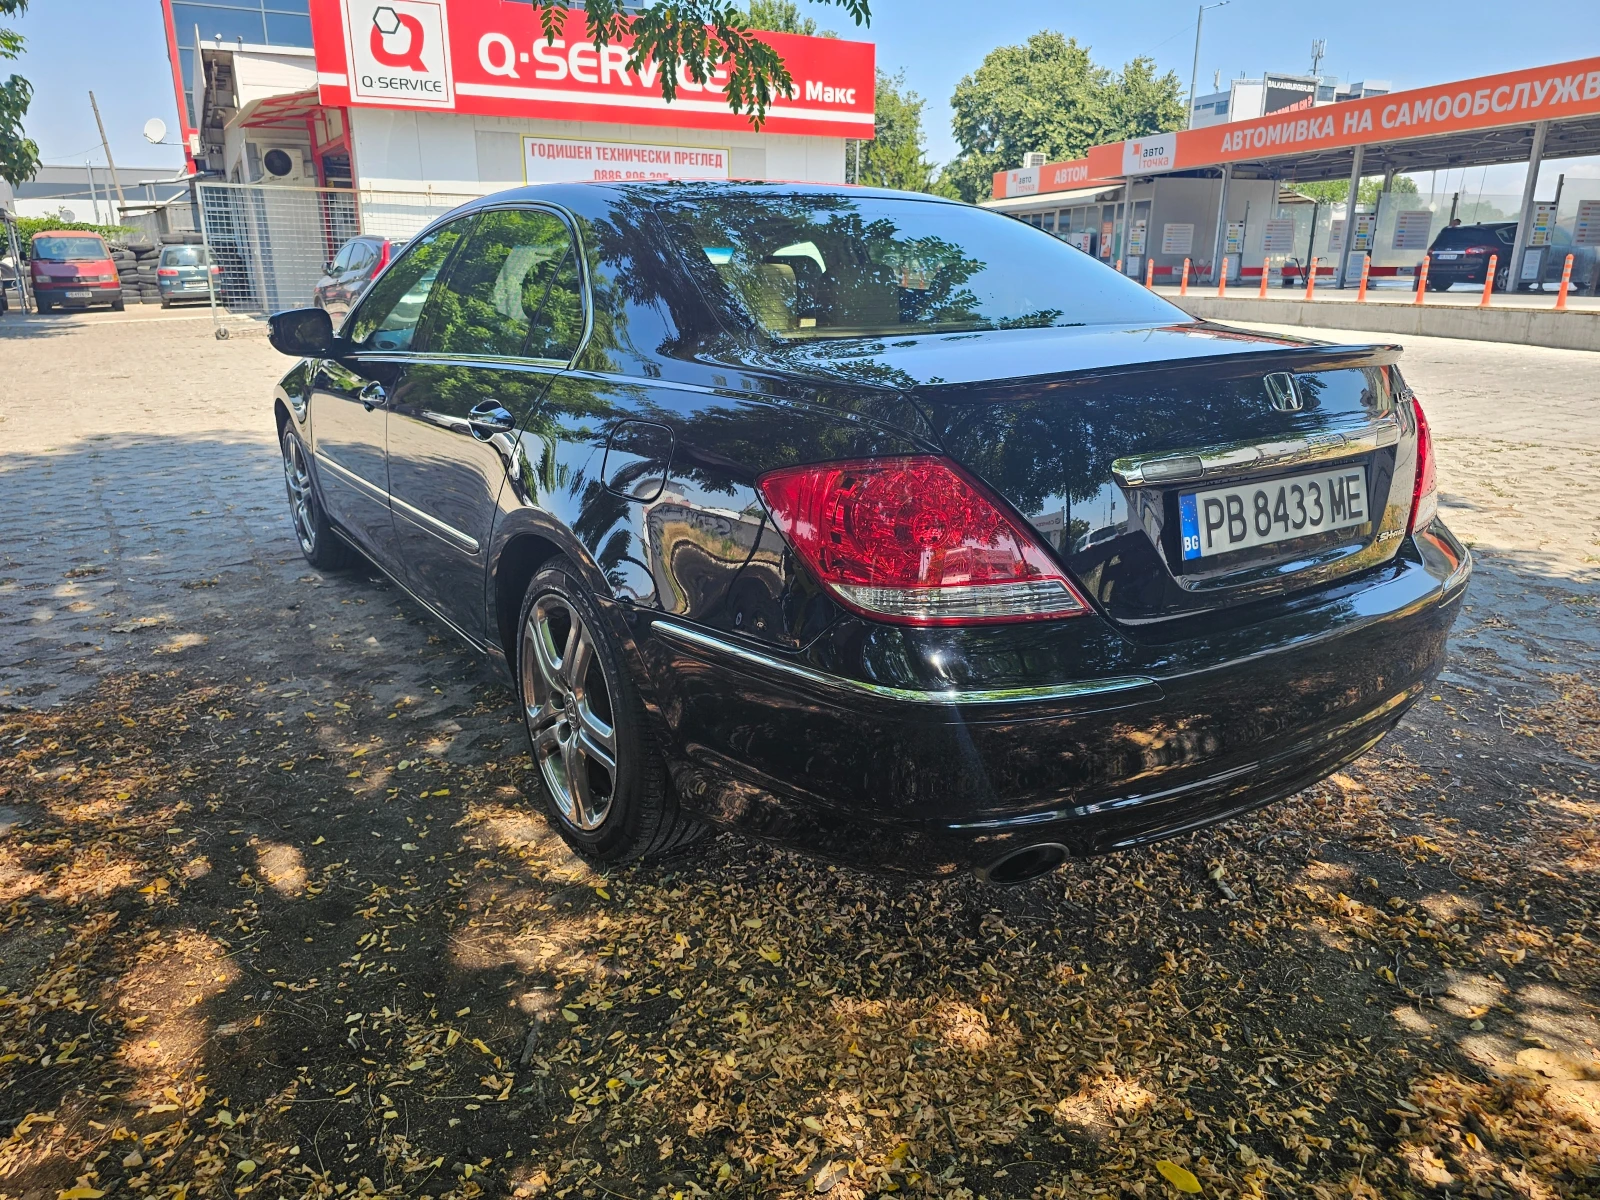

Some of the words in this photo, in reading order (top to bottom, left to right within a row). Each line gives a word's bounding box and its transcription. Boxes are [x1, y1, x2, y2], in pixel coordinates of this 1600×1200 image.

[478, 32, 730, 94] Q·SERVCE
[805, 80, 856, 105] Макс
[1220, 115, 1335, 153] АВТОМИВКА
[1342, 108, 1373, 135] НА
[531, 143, 592, 160] ГОДИШЕН
[596, 146, 671, 164] ТЕХНИЧЕСКИ
[674, 152, 723, 169] ПРЕГЛЕД
[1143, 146, 1164, 158] авто
[1143, 156, 1169, 169] точка
[1203, 494, 1247, 548] PB
[1253, 481, 1324, 537] 8433
[1328, 474, 1363, 523] ME
[1184, 535, 1199, 552] BG
